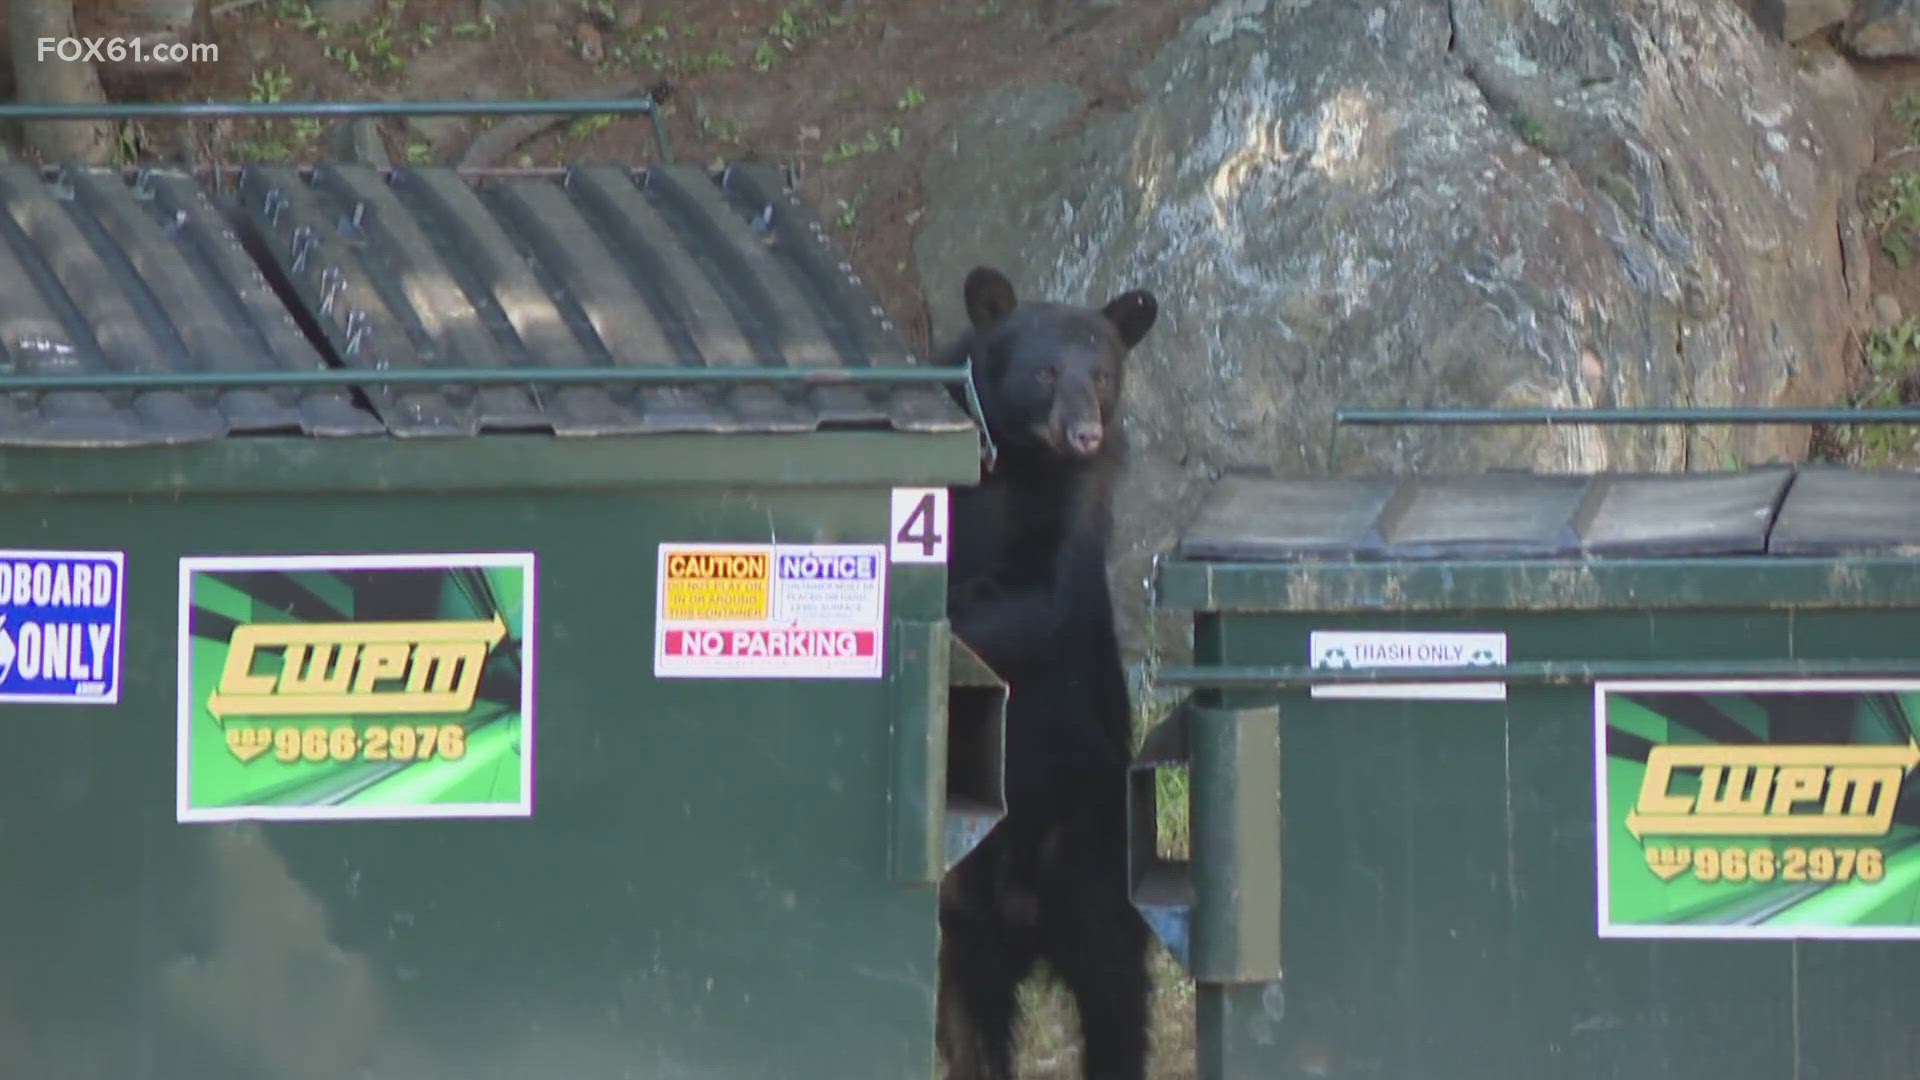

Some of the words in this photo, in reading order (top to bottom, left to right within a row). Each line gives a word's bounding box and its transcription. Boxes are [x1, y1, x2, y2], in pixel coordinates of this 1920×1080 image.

[897, 493, 943, 556] 4
[669, 556, 765, 578] CAUTION
[783, 556, 874, 578] NOTICE
[714, 582, 741, 592] PLAY
[709, 595, 758, 605] AROUND
[697, 609, 763, 619] CONTAINER
[17, 621, 112, 680] ONLY
[680, 632, 725, 656] NO
[732, 632, 858, 656] PARKING
[1354, 643, 1411, 661] TRASH
[1417, 643, 1464, 661] ONLY
[217, 622, 491, 715] CWPM
[1637, 745, 1905, 836] CWPM
